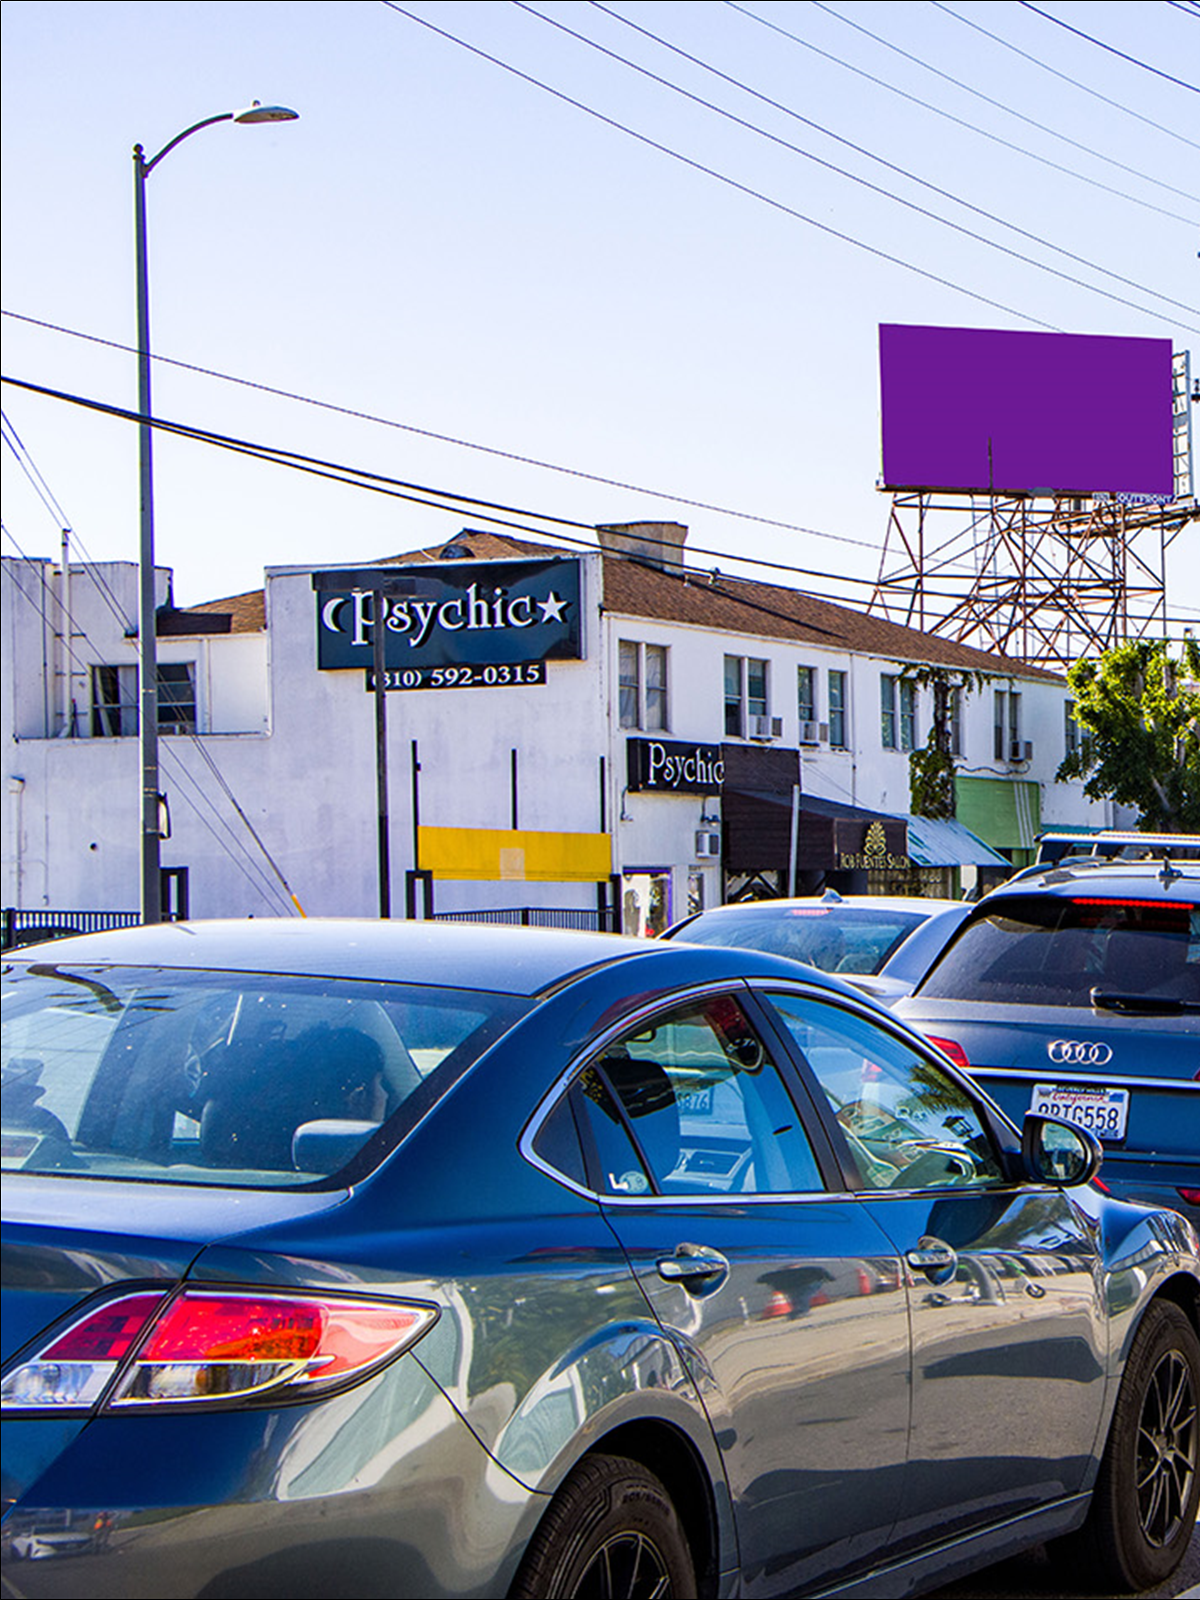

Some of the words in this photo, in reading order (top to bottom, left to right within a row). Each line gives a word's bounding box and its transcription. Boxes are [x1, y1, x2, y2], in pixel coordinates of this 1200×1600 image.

[351, 583, 534, 648] Psychic
[431, 664, 541, 687] 592-0315
[648, 742, 725, 787] Psychic
